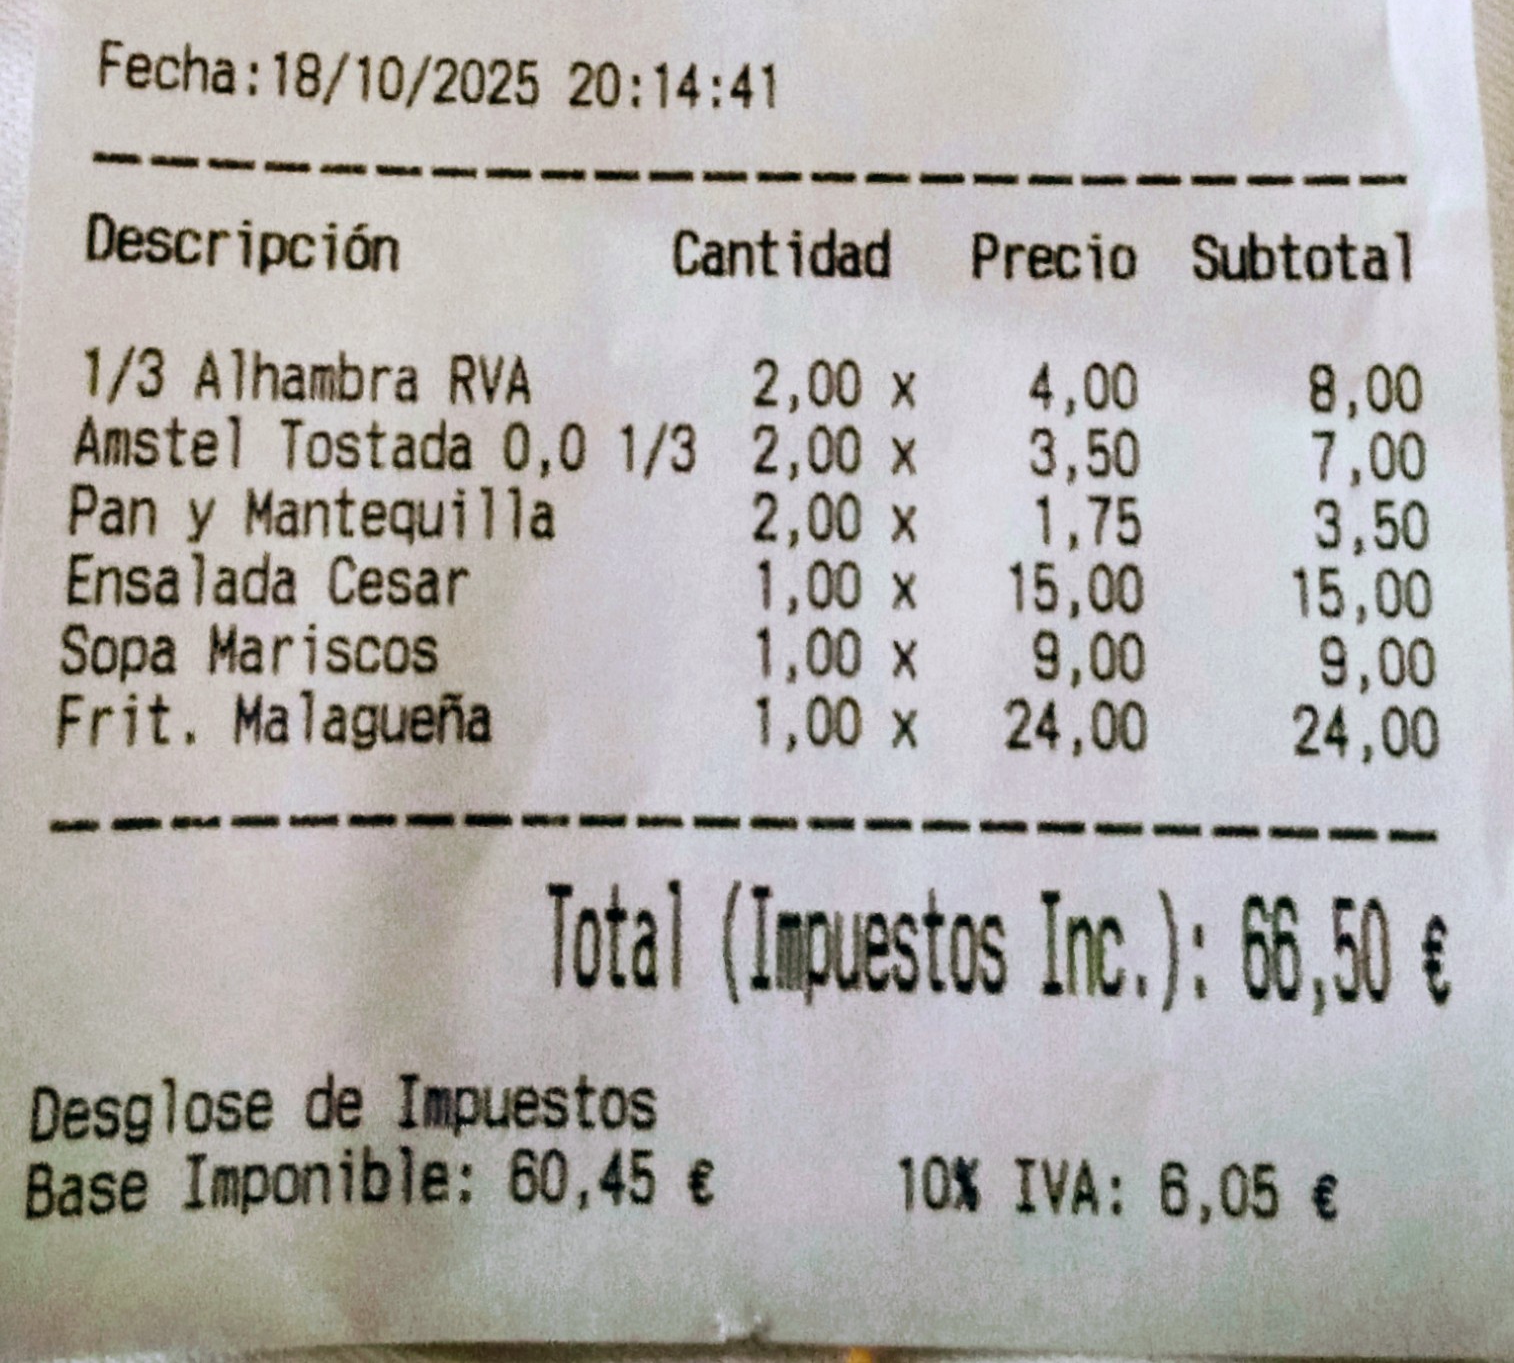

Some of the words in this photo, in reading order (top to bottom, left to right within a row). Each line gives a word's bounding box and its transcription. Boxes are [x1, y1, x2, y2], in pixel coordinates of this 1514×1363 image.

[567, 59, 777, 110] 20:14:41
[85, 210, 401, 277] Descripción
[672, 226, 892, 280] Cantidad
[971, 230, 1139, 282] Precio
[1191, 230, 1413, 284] Subtotal
[84, 344, 166, 406] 1/3
[193, 346, 420, 405] Alhambra
[448, 352, 532, 406] RVA
[752, 356, 863, 415] 2,00
[890, 370, 917, 409] x
[1028, 360, 1139, 418] 4,00
[1308, 362, 1424, 421] 8,00
[72, 413, 242, 469] Amstel
[279, 417, 474, 473] Tostada
[502, 420, 587, 480] 0,0
[620, 422, 697, 481] 1/3
[752, 422, 862, 483] 2,00
[890, 436, 917, 476] x
[1029, 426, 1141, 487] 3,50
[1311, 429, 1427, 488] 7,00
[67, 482, 158, 538] Pan
[186, 497, 217, 544] y
[244, 485, 557, 547] Mantequilla
[751, 489, 863, 549] 2,00
[890, 503, 918, 545] x
[1035, 493, 1143, 553] 1,75
[1313, 497, 1430, 557] 3,50
[65, 550, 298, 608] Ensalada
[327, 553, 471, 608] Cesar
[757, 558, 863, 617] 1,00
[891, 571, 917, 611] x
[1008, 560, 1145, 620] 15,00
[1292, 566, 1434, 625] 15,00
[59, 622, 178, 684] Sopa
[207, 622, 440, 676] Mariscos
[755, 625, 863, 685] 1,00
[891, 639, 919, 681] x
[1032, 628, 1147, 690] 9,00
[1318, 634, 1437, 696] 9,00
[56, 692, 197, 750] Frit.
[233, 688, 494, 753] Malagueña
[755, 693, 863, 754] 1,00
[891, 708, 918, 749] x
[1003, 696, 1148, 758] 24,00
[1291, 702, 1441, 765] 24,00
[545, 878, 683, 991] Total
[721, 880, 1008, 1007] (Impuestos
[1039, 888, 1208, 1013] Inc.):
[1241, 893, 1392, 1017] 66,50
[1420, 913, 1452, 1008] €
[28, 1076, 275, 1147] Desglose
[304, 1071, 364, 1132] de
[396, 1071, 658, 1139] Impuestos
[24, 1160, 149, 1222] Base
[182, 1143, 473, 1217] Imponible:
[508, 1146, 657, 1212] 60,45
[686, 1157, 716, 1208] €
[897, 1154, 982, 1214] 10%
[1013, 1156, 1124, 1217] IVA:
[1159, 1159, 1280, 1226] 6,05
[1309, 1172, 1340, 1224] €
